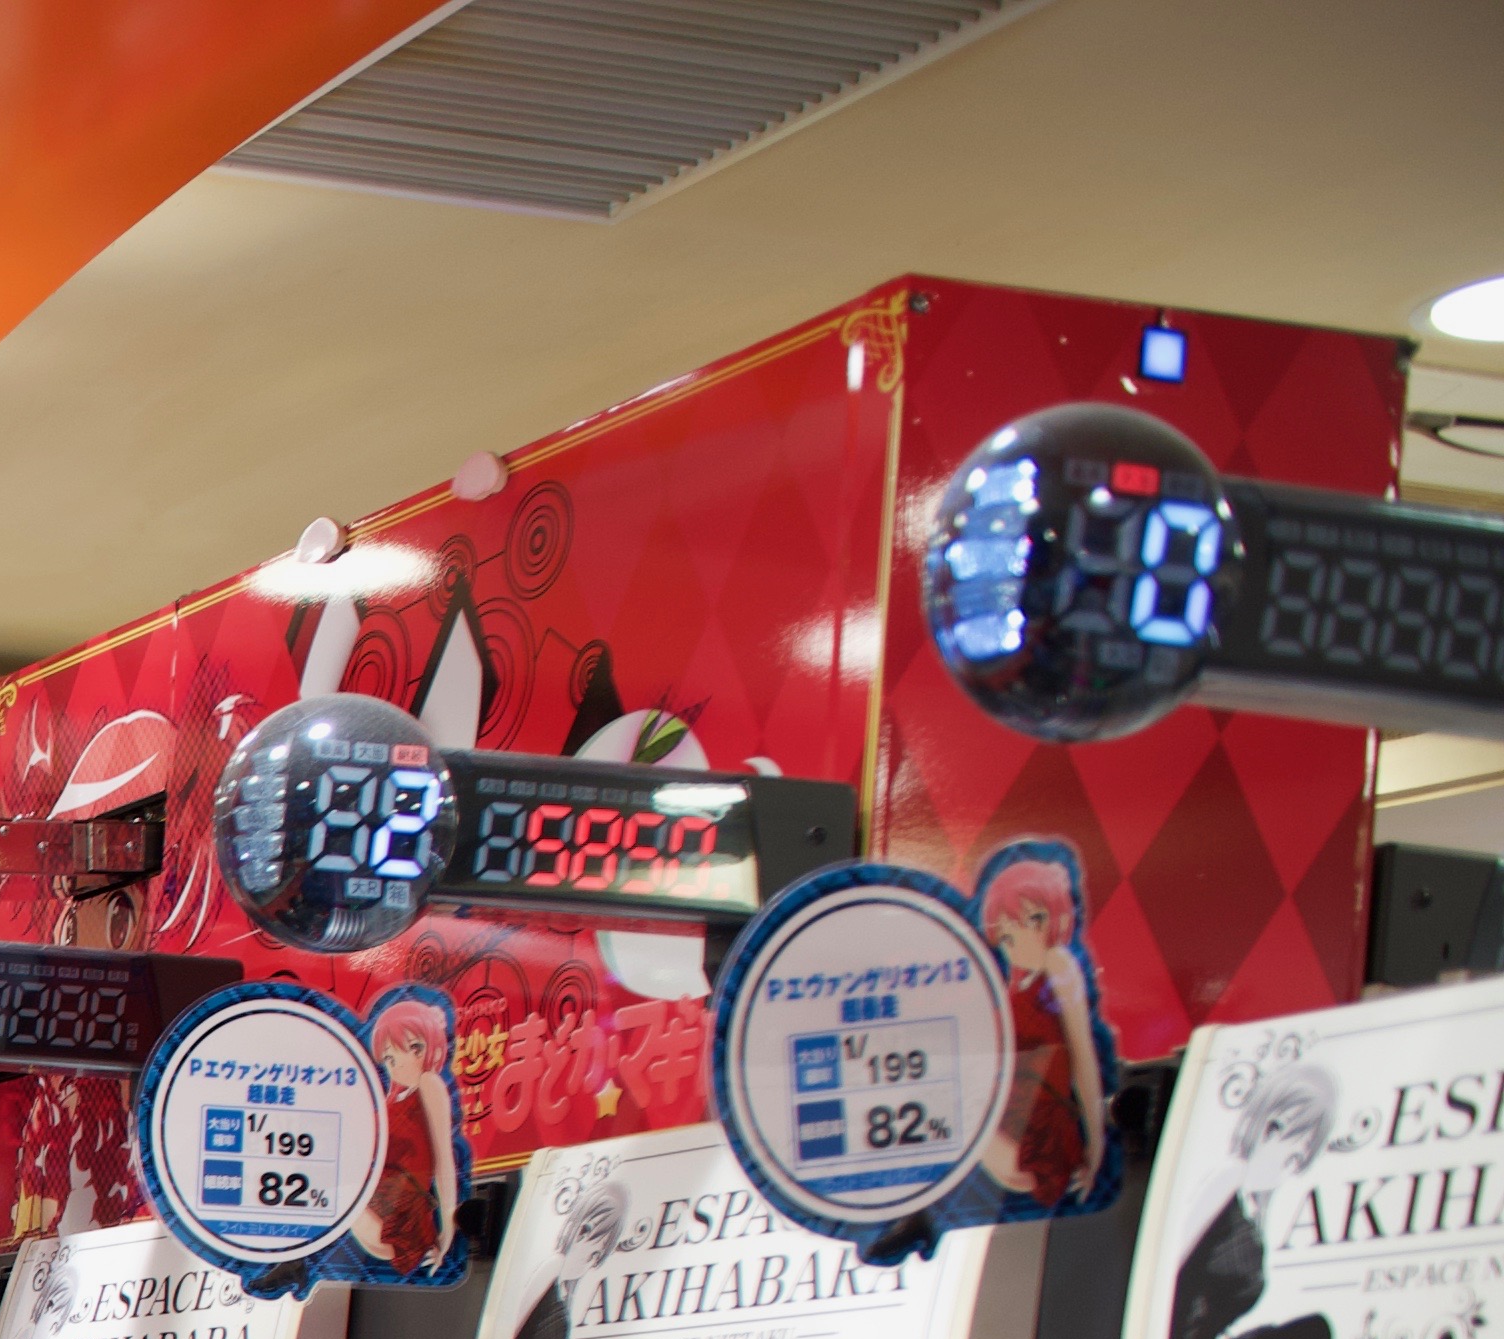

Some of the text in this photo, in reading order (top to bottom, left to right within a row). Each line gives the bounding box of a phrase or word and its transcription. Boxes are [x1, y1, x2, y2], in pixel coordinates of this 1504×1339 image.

[1129, 499, 1223, 648] 0
[369, 768, 441, 878] 2
[349, 879, 408, 905] 大R 箱
[189, 1058, 357, 1086] Pエヴァンゲリオン13
[867, 1101, 951, 1149] 82%
[259, 1172, 328, 1208] 82%
[1278, 1163, 1504, 1251] AKIH
[89, 1269, 219, 1324] ESPACE
[1363, 1258, 1478, 1292] ESPACE
